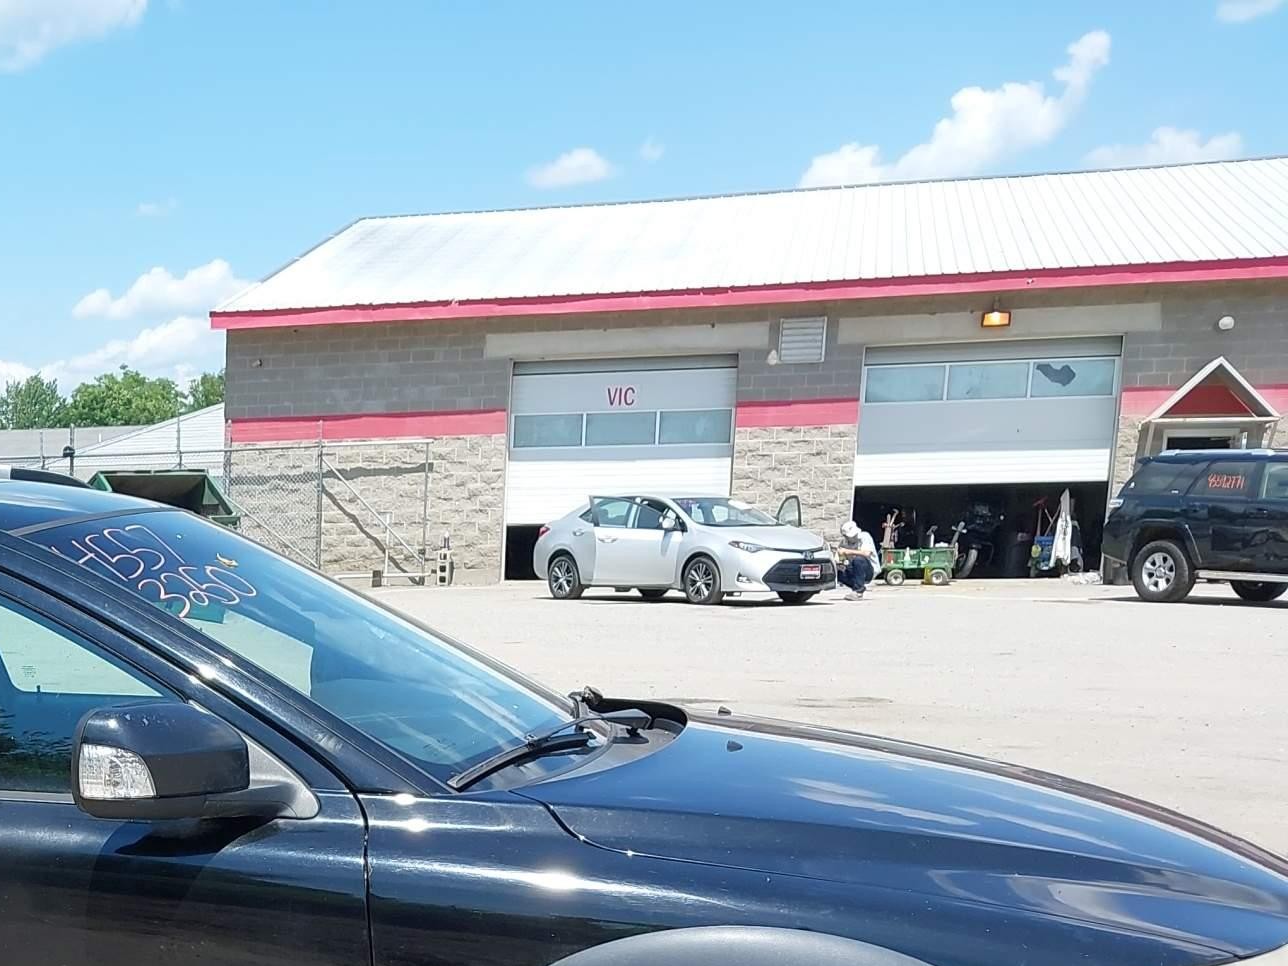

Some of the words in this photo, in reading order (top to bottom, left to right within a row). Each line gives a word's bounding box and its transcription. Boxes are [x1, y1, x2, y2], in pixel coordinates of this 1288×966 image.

[607, 387, 636, 406] VIC
[51, 524, 186, 583] 4557
[137, 565, 258, 619] 3250
